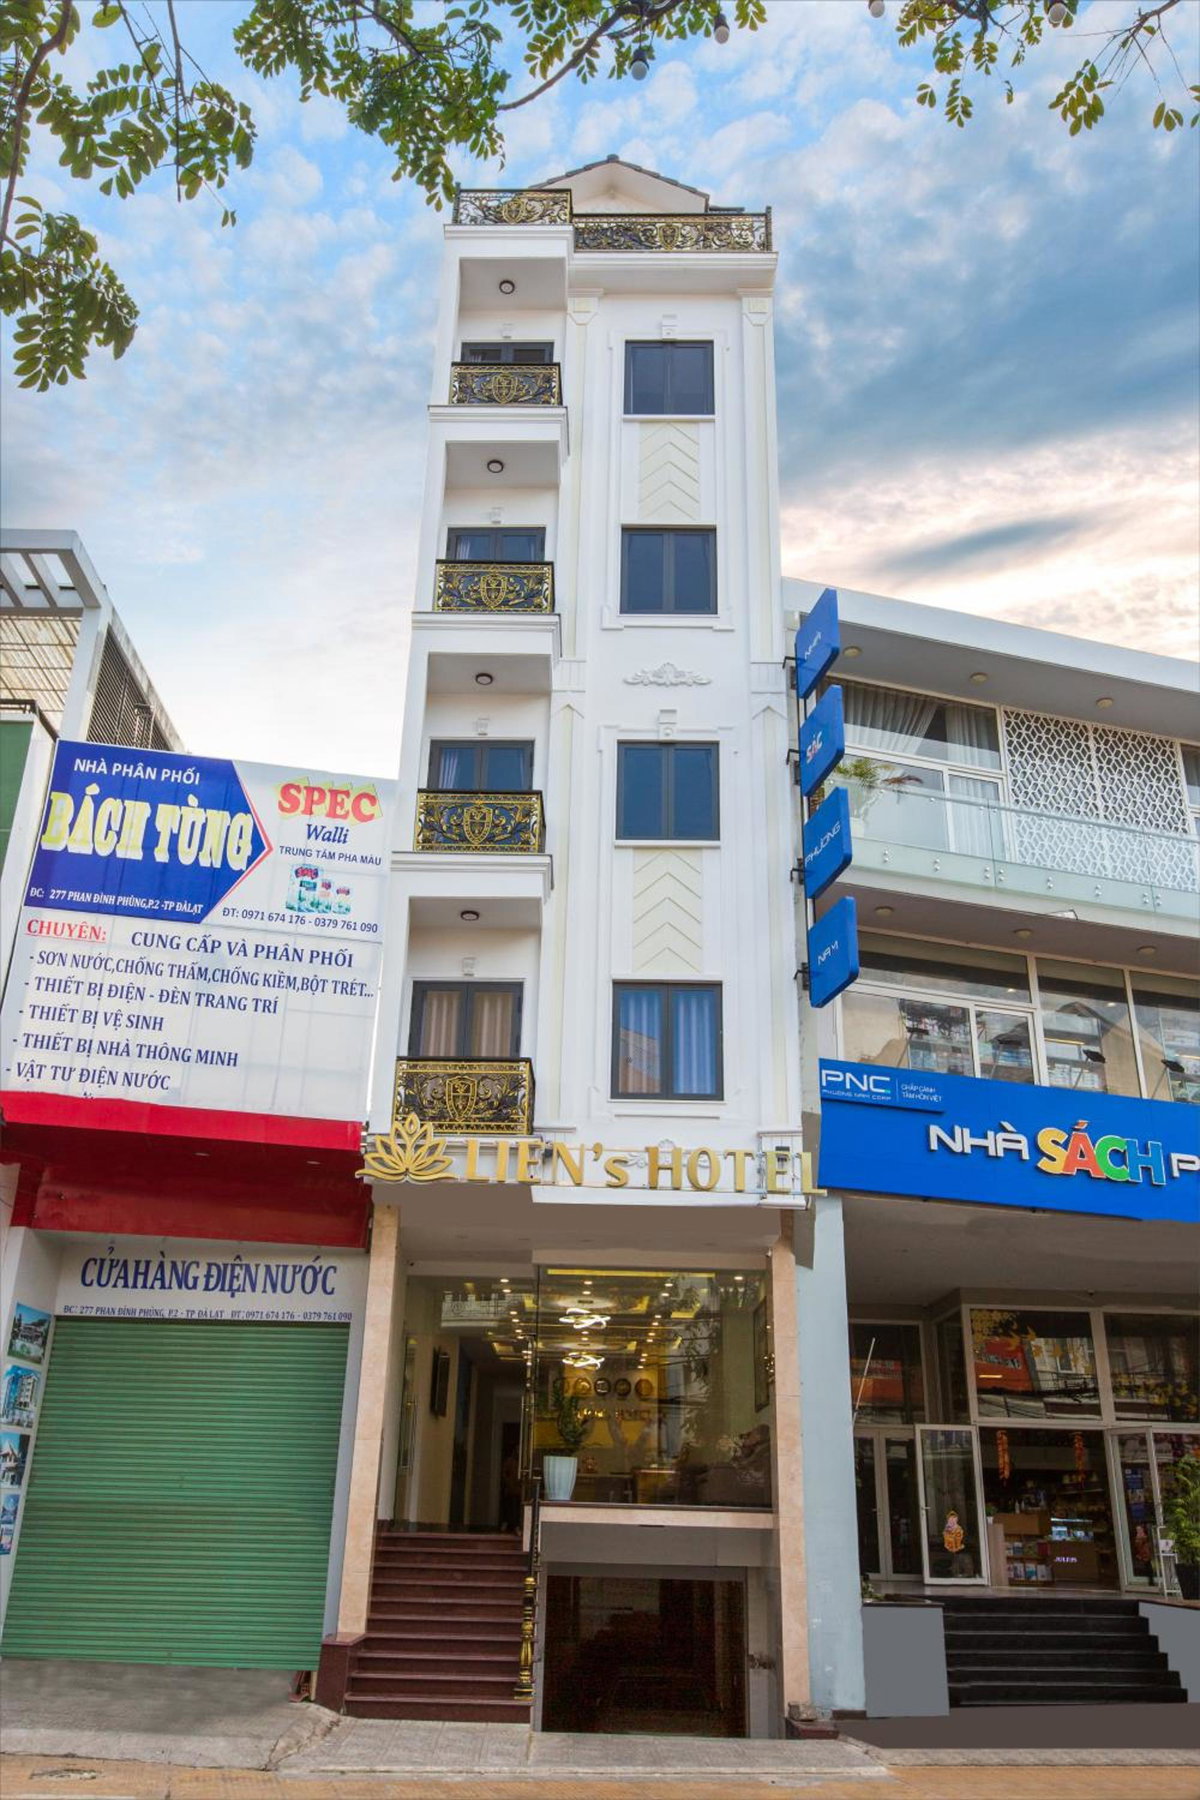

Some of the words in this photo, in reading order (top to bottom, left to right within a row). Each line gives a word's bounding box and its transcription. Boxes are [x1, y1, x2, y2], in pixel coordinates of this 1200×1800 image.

[74, 758, 108, 775] NHÀ
[112, 763, 156, 780] PHÂN
[161, 766, 200, 785] PHỐI
[278, 783, 377, 823] SPEC
[41, 783, 151, 860] BÁCH
[154, 794, 253, 871] TÙNG
[306, 824, 349, 844] Walli
[279, 846, 312, 857] TRUNG
[338, 854, 357, 863] PHA
[360, 854, 382, 866] MÀU
[30, 887, 44, 898] ĐC:
[49, 889, 66, 900] 277
[67, 891, 92, 903] PHAN
[93, 892, 115, 905] ĐÌNH
[222, 907, 239, 918] ĐT:
[241, 909, 265, 922] 0971
[268, 912, 286, 924] 674
[289, 914, 306, 925] 176
[314, 917, 338, 930] 0379
[340, 920, 357, 931] 761
[360, 922, 378, 933] 090
[26, 918, 107, 943] CHUYÊN:
[131, 932, 181, 950] CUNG
[186, 935, 221, 955] CẤP
[226, 939, 248, 957] VÀ
[253, 943, 304, 963] PHÂN
[309, 948, 354, 968] PHỐI
[37, 951, 68, 967] SƠN
[35, 974, 83, 995] THIẾT
[87, 981, 103, 1001] BỊ
[107, 982, 146, 1004] ĐIỆN
[159, 986, 191, 1006] ĐÈN
[195, 992, 248, 1011] TRANG
[252, 996, 279, 1014] TRÍ
[29, 1003, 78, 1023] THIẾT
[82, 1009, 98, 1029] BỊ
[103, 1009, 122, 1031] VỆ
[126, 1014, 164, 1031] SINH
[23, 1032, 73, 1052] THIẾT
[76, 1038, 93, 1058] BỊ
[96, 1037, 131, 1057] NHÀ
[136, 1043, 192, 1063] THÔNG
[195, 1049, 239, 1067] MINH
[16, 1059, 47, 1082] VẬT
[50, 1064, 76, 1081] TƯ
[79, 1066, 118, 1088] ĐIỆN
[121, 1071, 171, 1090] NƯỚC
[821, 1069, 891, 1094] PNC
[929, 1121, 1030, 1161] NHÀ
[1036, 1119, 1167, 1186] SÁCH
[466, 1139, 629, 1188] LIEN's
[645, 1145, 828, 1197] HOTEL
[202, 1255, 260, 1298] ĐIỆN
[262, 1255, 338, 1295] NƯỚC
[80, 1306, 94, 1314] 277
[95, 1306, 116, 1315] PHAN
[246, 1311, 263, 1320] 0971
[265, 1312, 279, 1320] 674
[281, 1312, 295, 1320] 176
[303, 1312, 321, 1320] 0379
[323, 1312, 337, 1320] 761
[338, 1312, 352, 1320] 090
